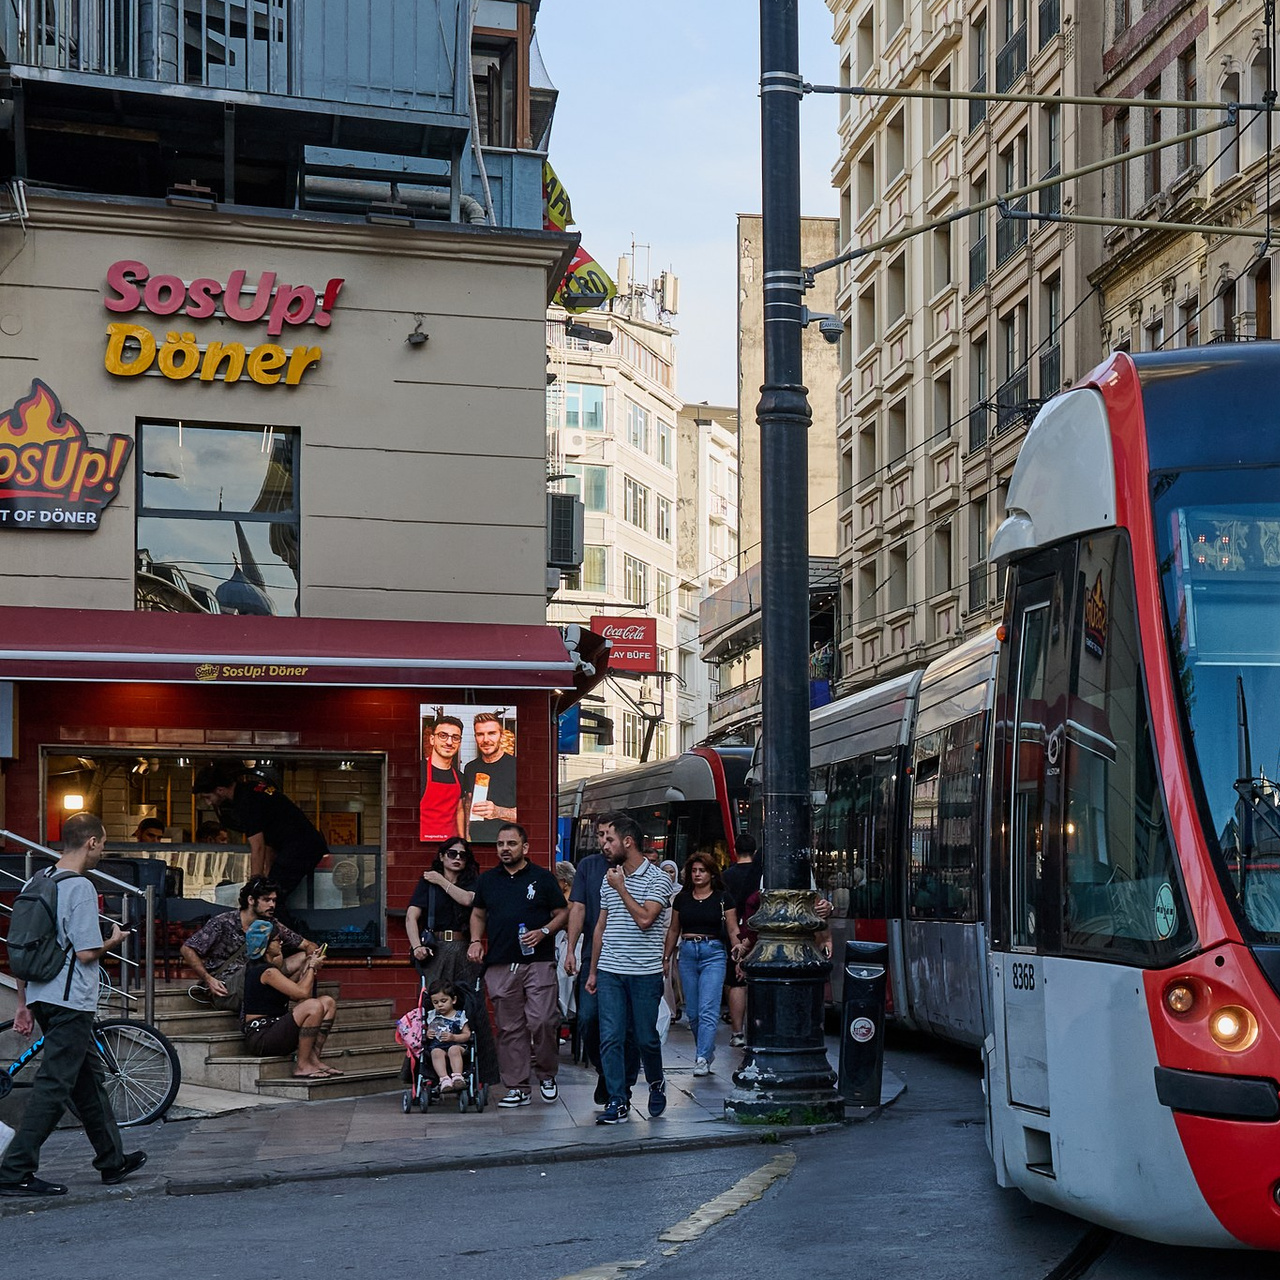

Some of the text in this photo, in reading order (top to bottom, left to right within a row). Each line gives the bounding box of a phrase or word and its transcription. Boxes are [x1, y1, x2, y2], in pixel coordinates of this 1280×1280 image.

[103, 259, 346, 337] SosUp!
[104, 322, 322, 385] Döner
[14, 510, 36, 522] OF
[40, 508, 97, 524] DÖNER
[602, 624, 646, 640] Coca-Cola
[627, 650, 651, 659] BÜFE
[222, 666, 265, 678] SosUp!
[269, 666, 308, 676] Döner
[1012, 962, 1035, 991] 836B
